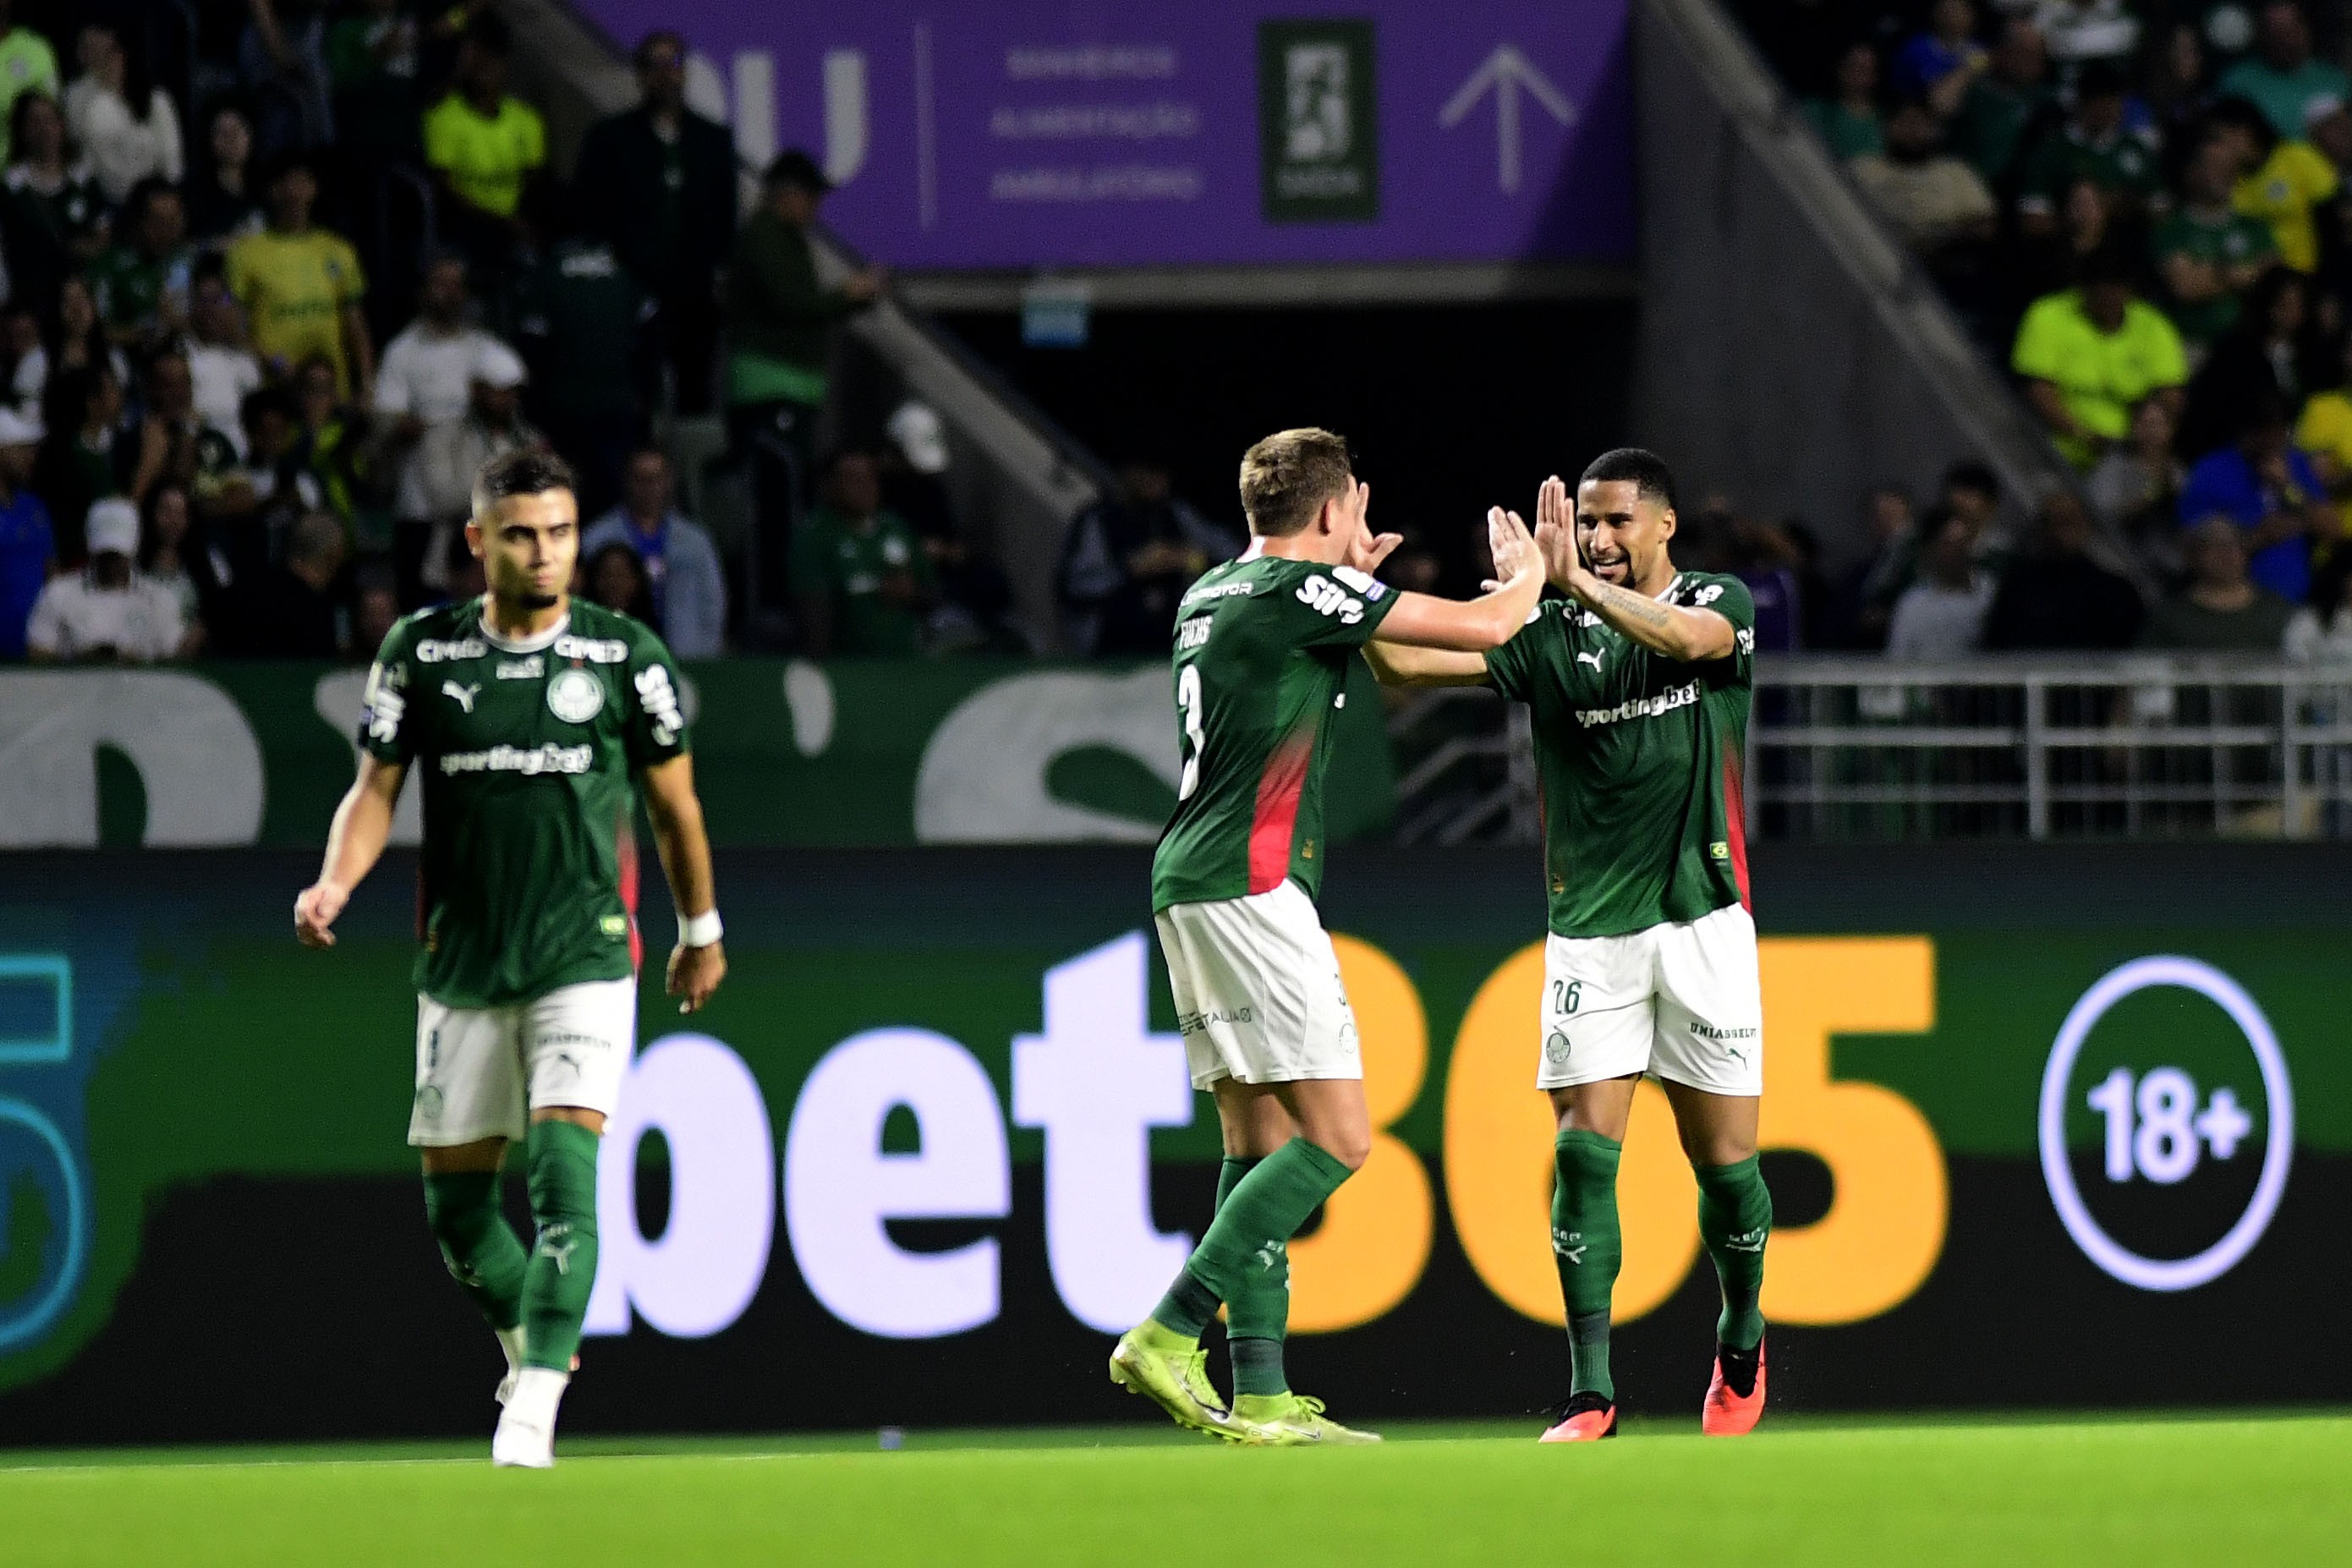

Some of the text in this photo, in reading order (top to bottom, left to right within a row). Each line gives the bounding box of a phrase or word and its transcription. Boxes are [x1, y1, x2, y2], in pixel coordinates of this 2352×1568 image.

[1178, 664, 1205, 801] 3
[1575, 677, 1701, 728] sportingbet
[1553, 979, 1582, 1015] 26
[579, 929, 1947, 1336] bet365
[2091, 1071, 2250, 1181] 18+
